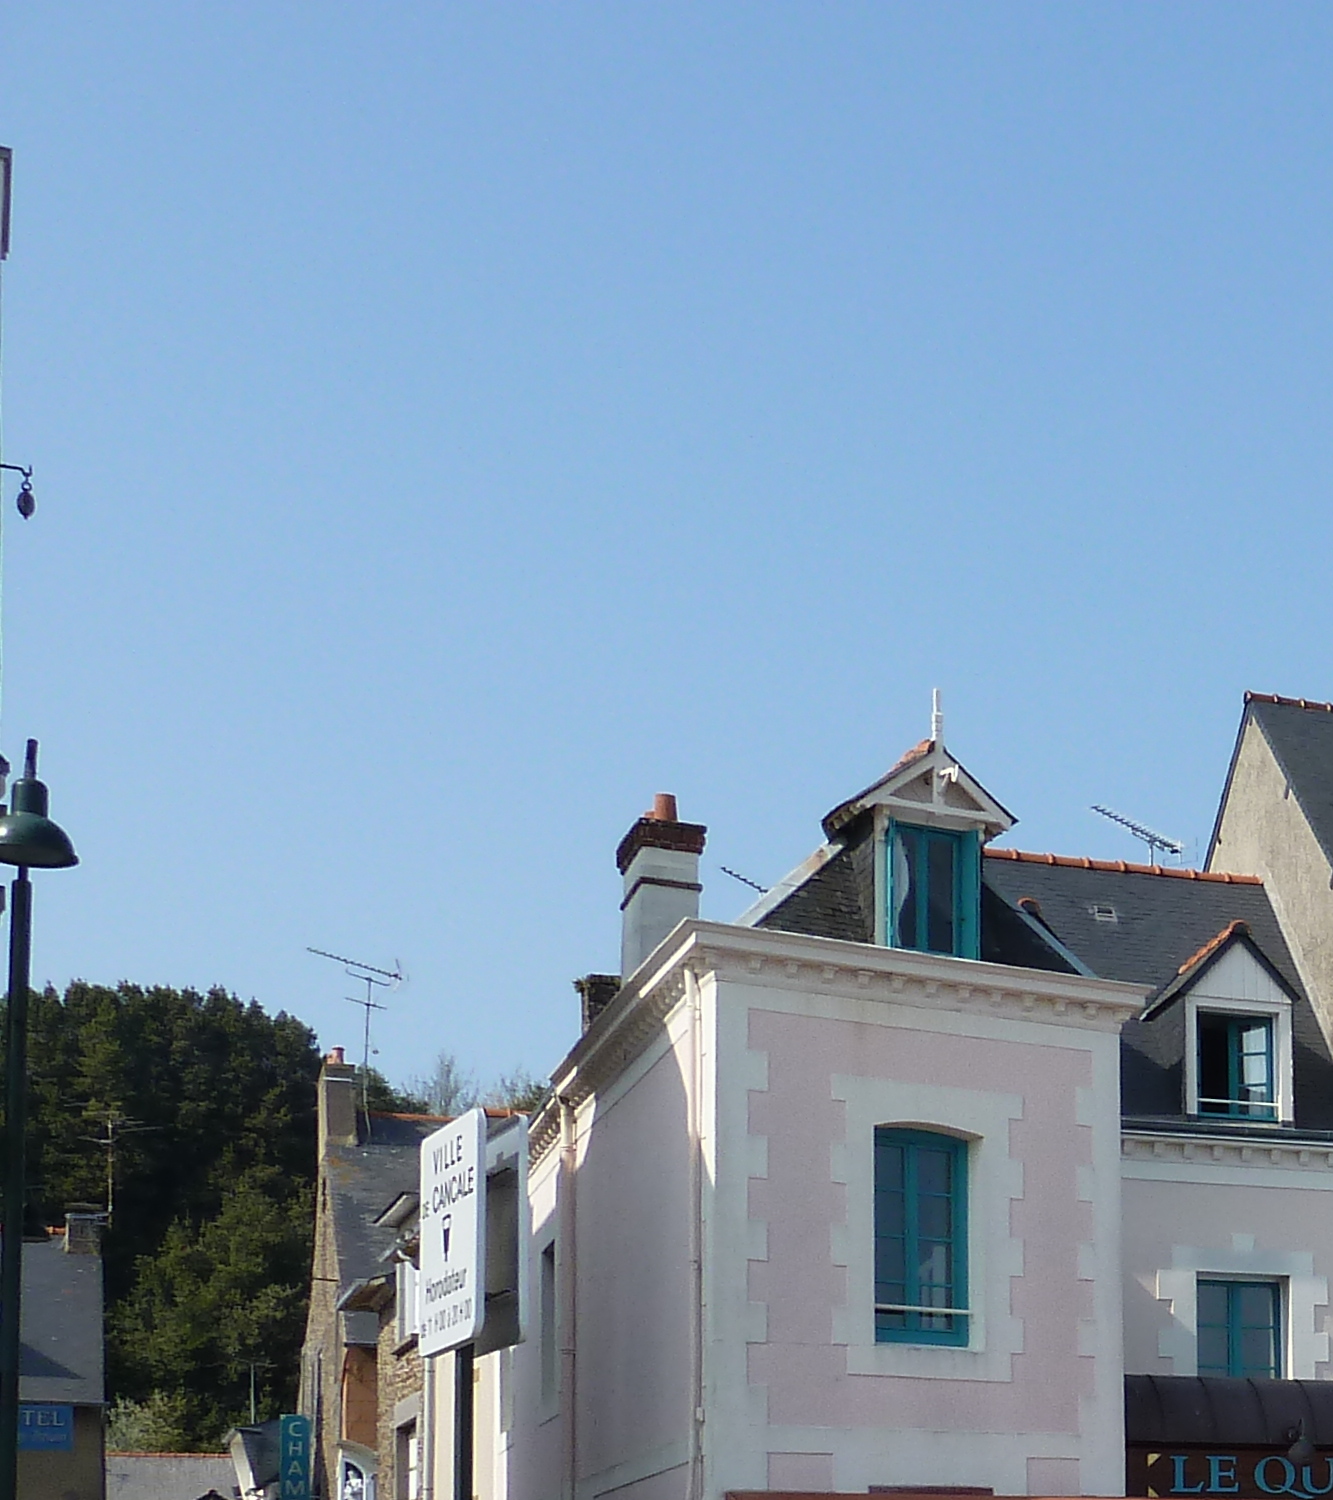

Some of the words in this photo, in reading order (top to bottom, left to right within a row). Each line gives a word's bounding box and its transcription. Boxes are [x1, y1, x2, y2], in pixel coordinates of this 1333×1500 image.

[433, 1134, 463, 1175] VILLE
[433, 1166, 474, 1213] CANCALE
[425, 1268, 467, 1304] Horodateur
[1169, 1455, 1240, 1493] LE
